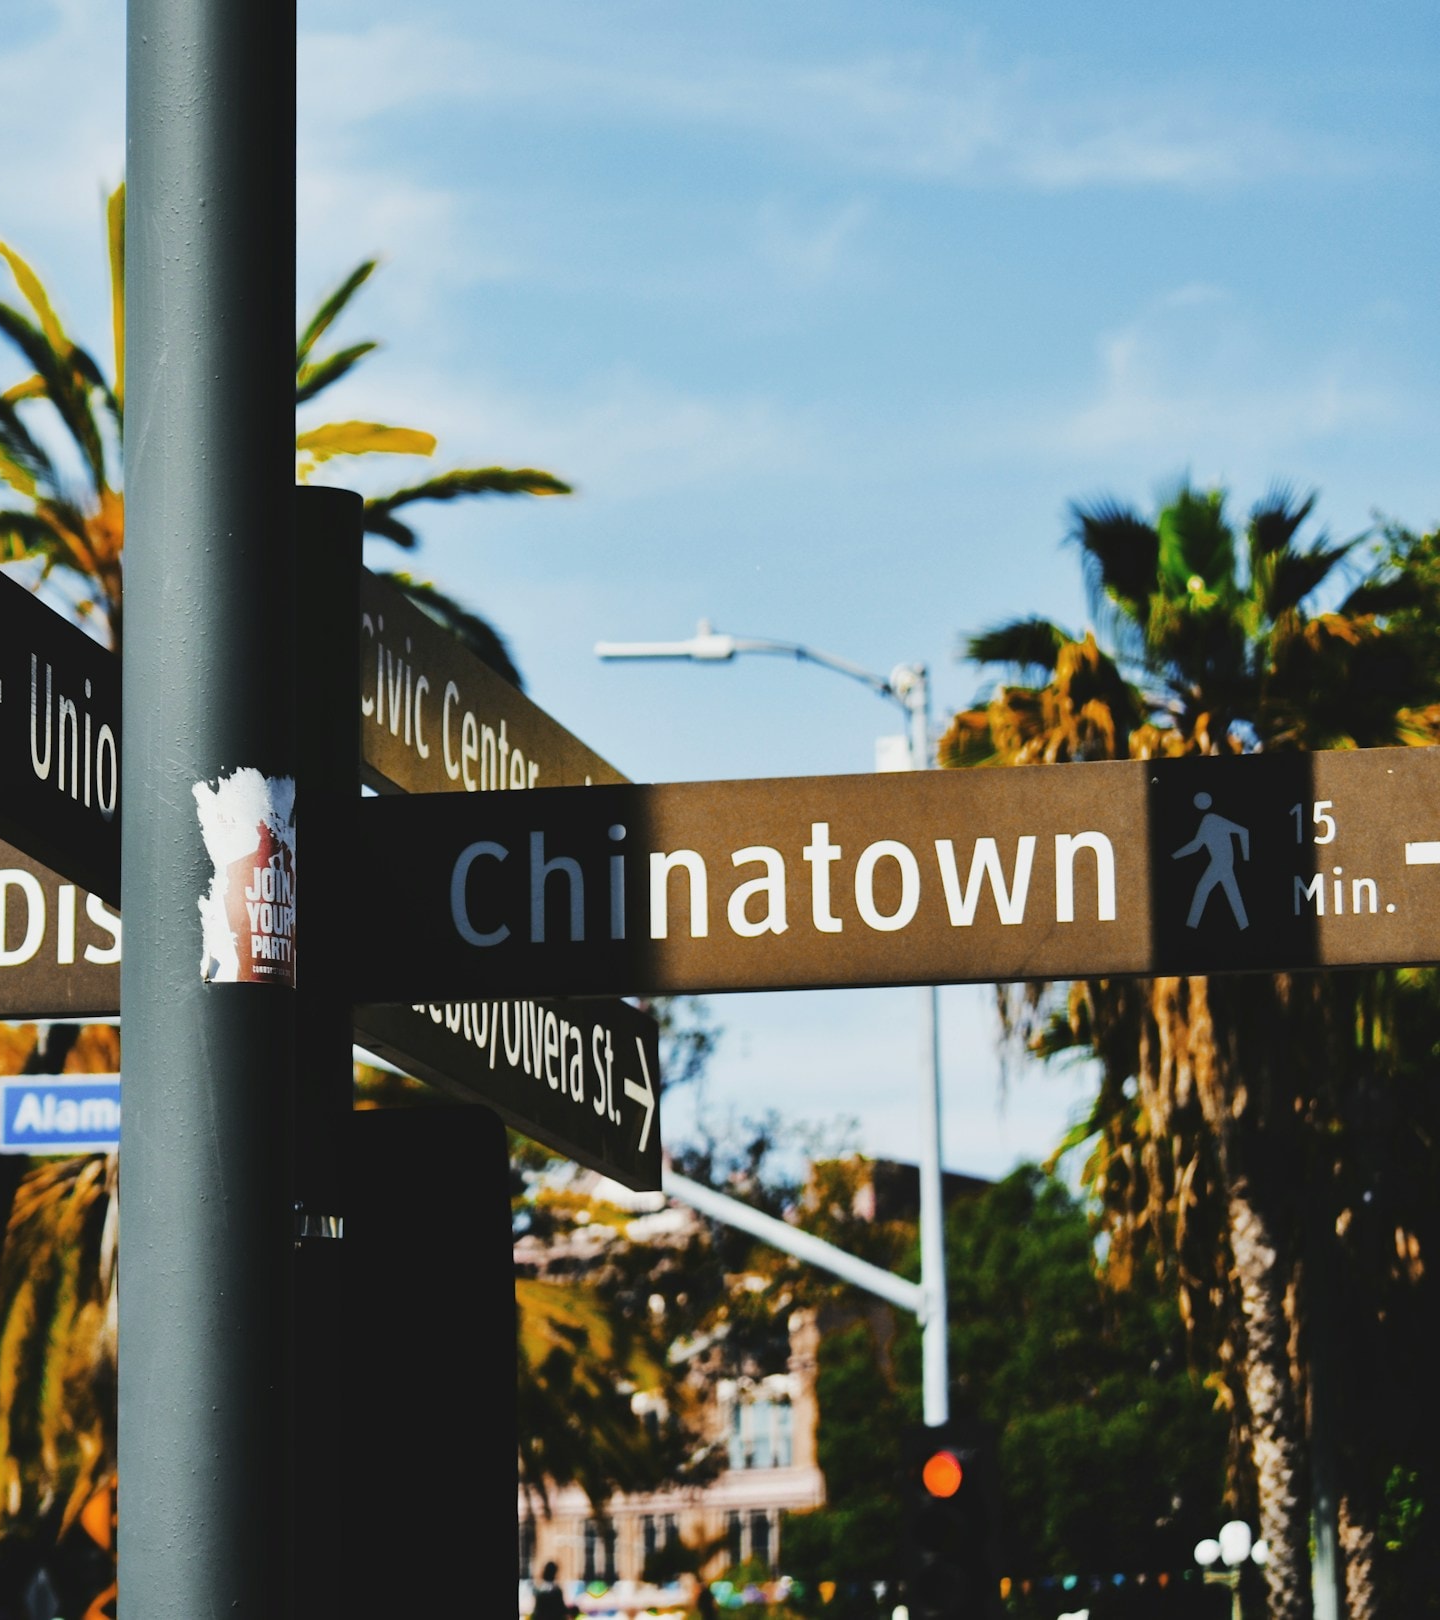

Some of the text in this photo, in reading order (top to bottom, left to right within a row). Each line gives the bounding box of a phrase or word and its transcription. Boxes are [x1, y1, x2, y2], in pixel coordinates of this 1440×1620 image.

[30, 652, 118, 822] Unio
[1289, 800, 1336, 845] 15
[244, 866, 291, 906] JOIN
[450, 822, 1117, 948] Chinatown
[1293, 866, 1396, 916] Min.
[245, 902, 293, 938] YOUR
[251, 935, 292, 963] PARTY
[592, 1024, 621, 1126] St.
